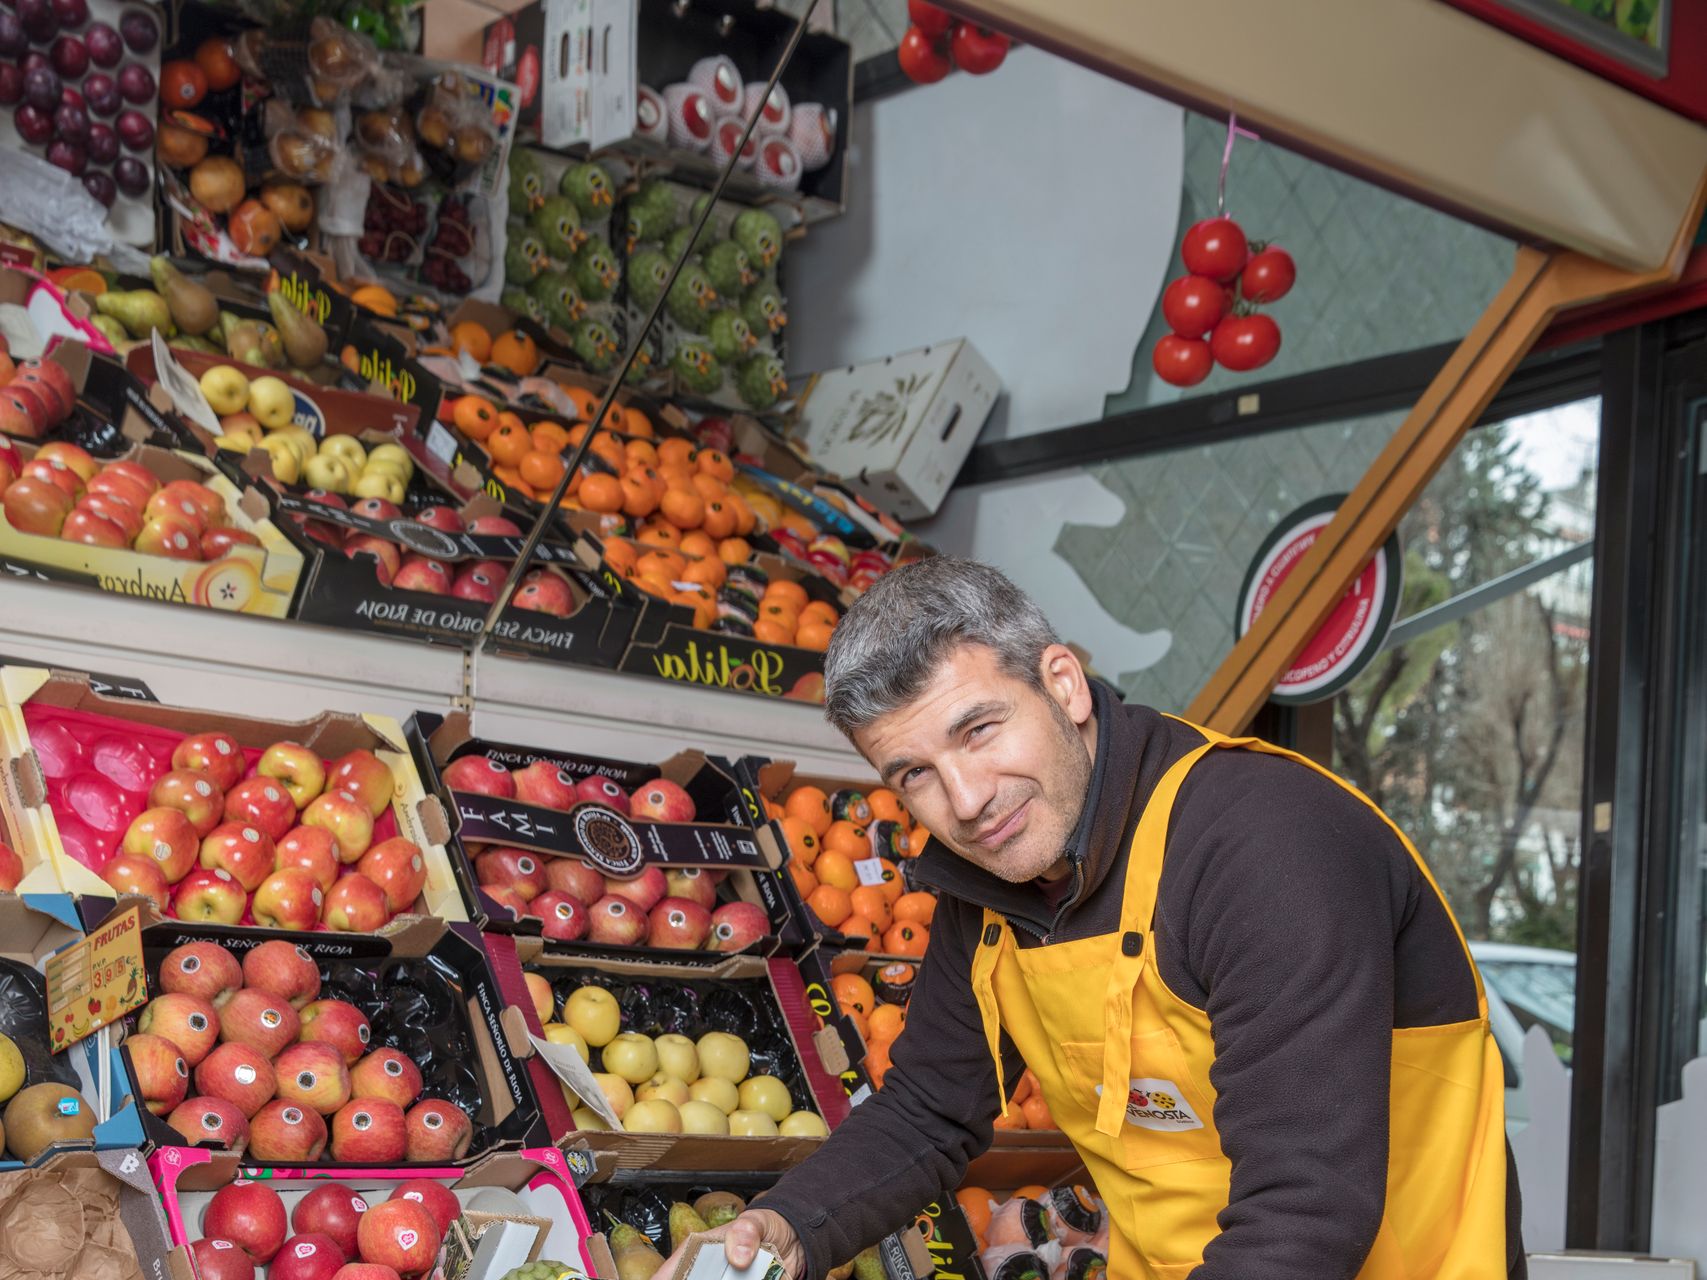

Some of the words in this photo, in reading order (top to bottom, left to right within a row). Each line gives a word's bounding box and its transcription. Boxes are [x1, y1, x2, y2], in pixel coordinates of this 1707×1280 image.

[484, 749, 522, 764] FINCA
[577, 761, 595, 775] DE
[596, 765, 629, 781] RIOJA
[94, 915, 136, 952] FRUTAS
[314, 943, 353, 955] RIOJA
[477, 982, 491, 1014] FINCA
[488, 1013, 507, 1059] SEÑORÍO
[503, 1058, 513, 1073] DE
[508, 1073, 523, 1105] RIOJA
